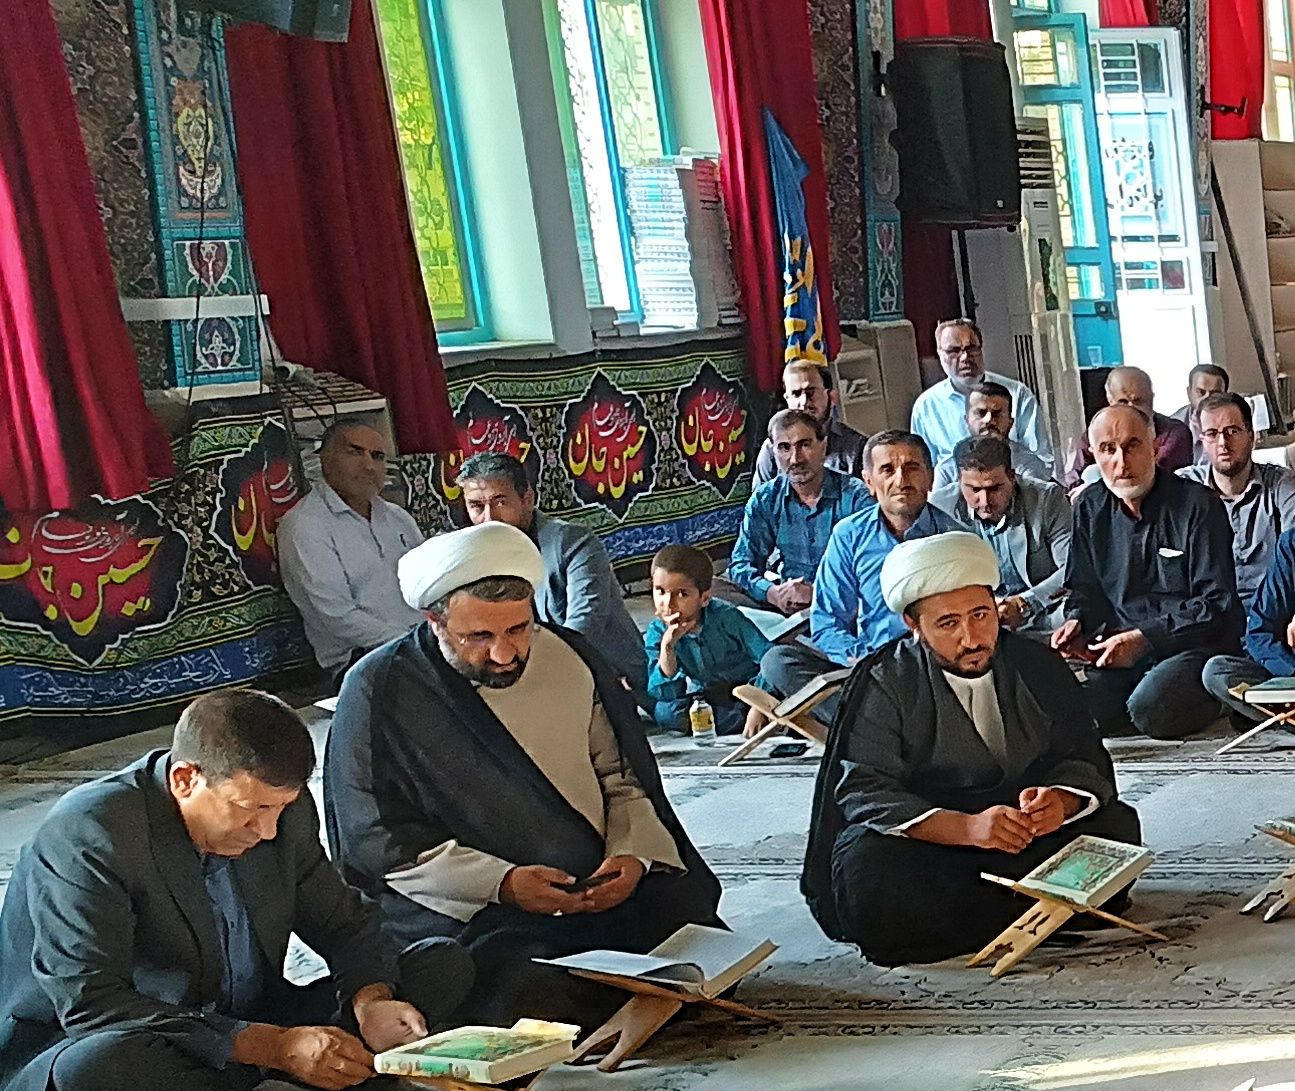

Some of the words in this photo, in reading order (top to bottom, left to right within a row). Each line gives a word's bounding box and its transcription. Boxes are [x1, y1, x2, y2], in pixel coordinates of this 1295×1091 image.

[569, 423, 607, 495] جان
[608, 426, 647, 499] حسین
[682, 407, 714, 472] جان
[63, 536, 164, 636] حسین
